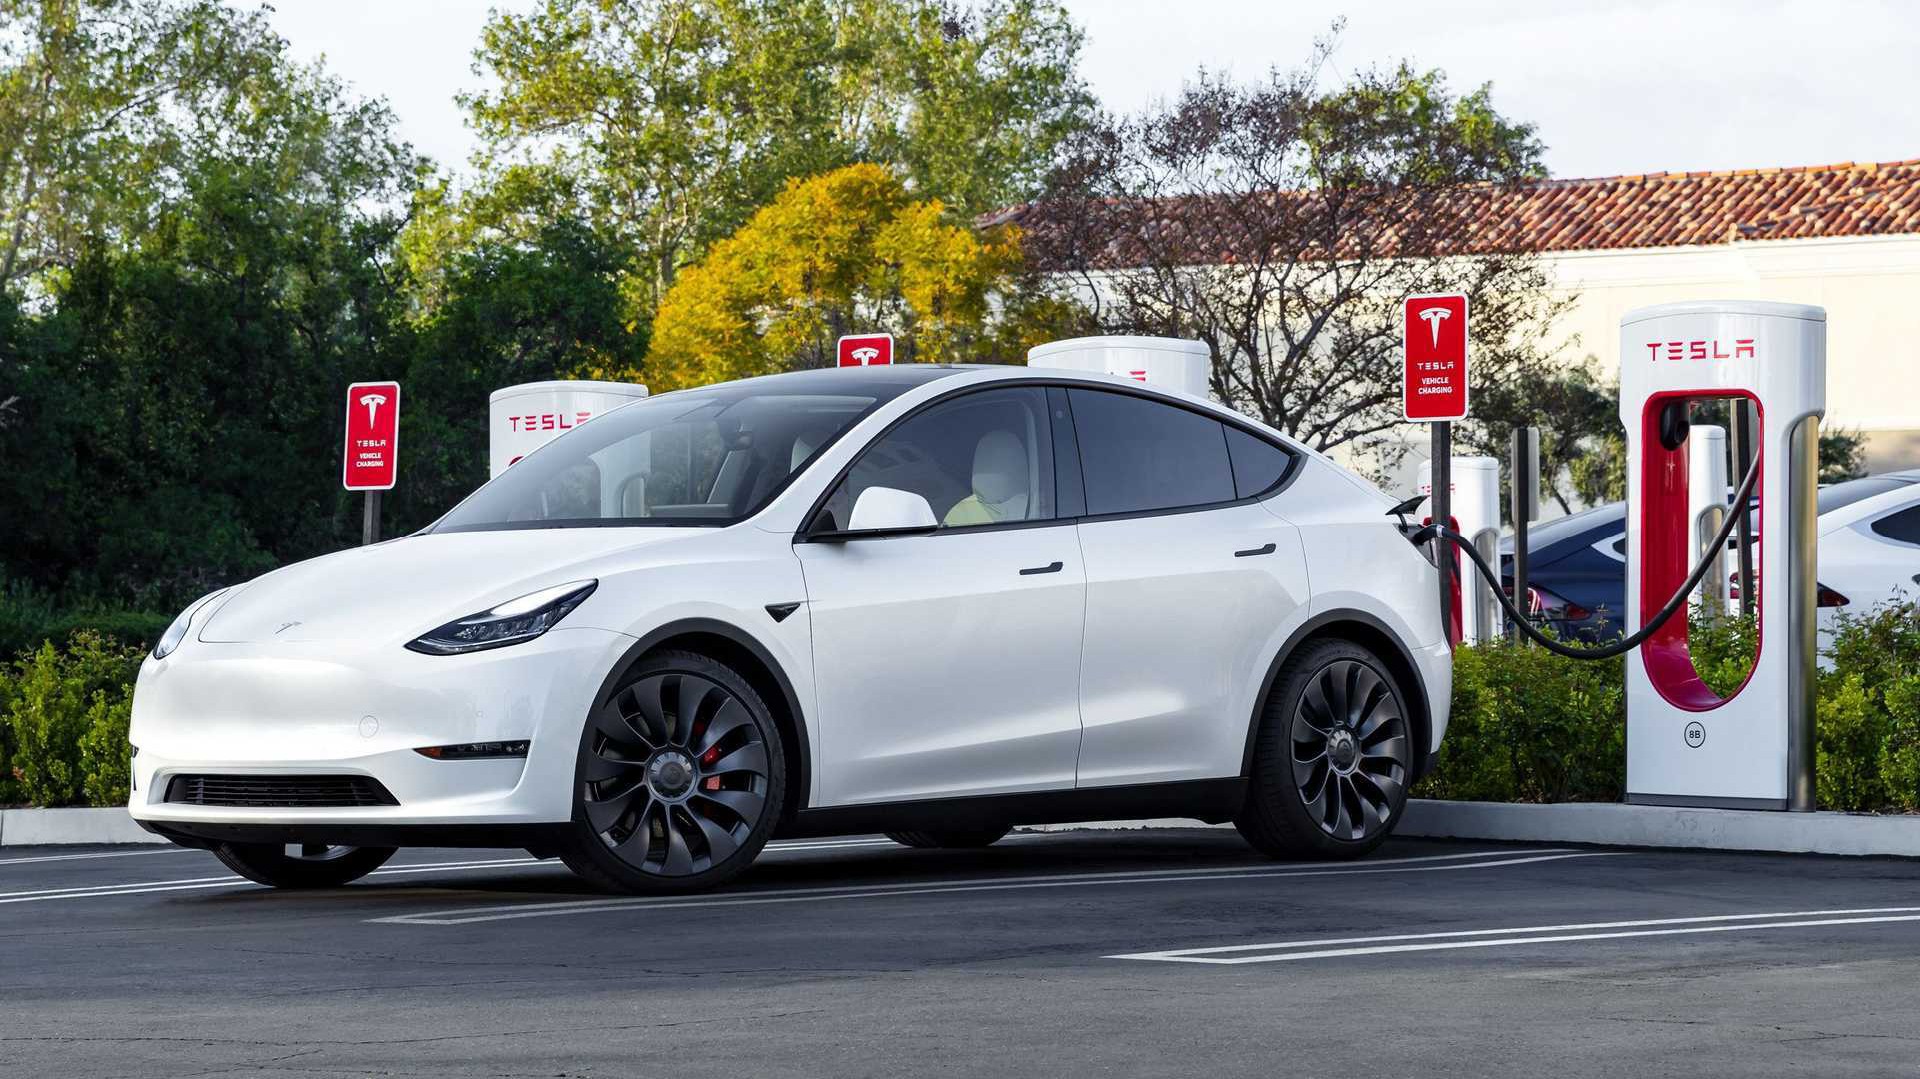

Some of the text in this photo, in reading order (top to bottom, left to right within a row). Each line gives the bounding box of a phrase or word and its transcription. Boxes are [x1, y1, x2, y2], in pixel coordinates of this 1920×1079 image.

[1646, 339, 1754, 361] TESLA
[1416, 361, 1454, 370] TESLA
[1421, 377, 1449, 385] VEHICLE
[1418, 387, 1452, 395] CHARGING
[1689, 730, 1701, 739] 8B
